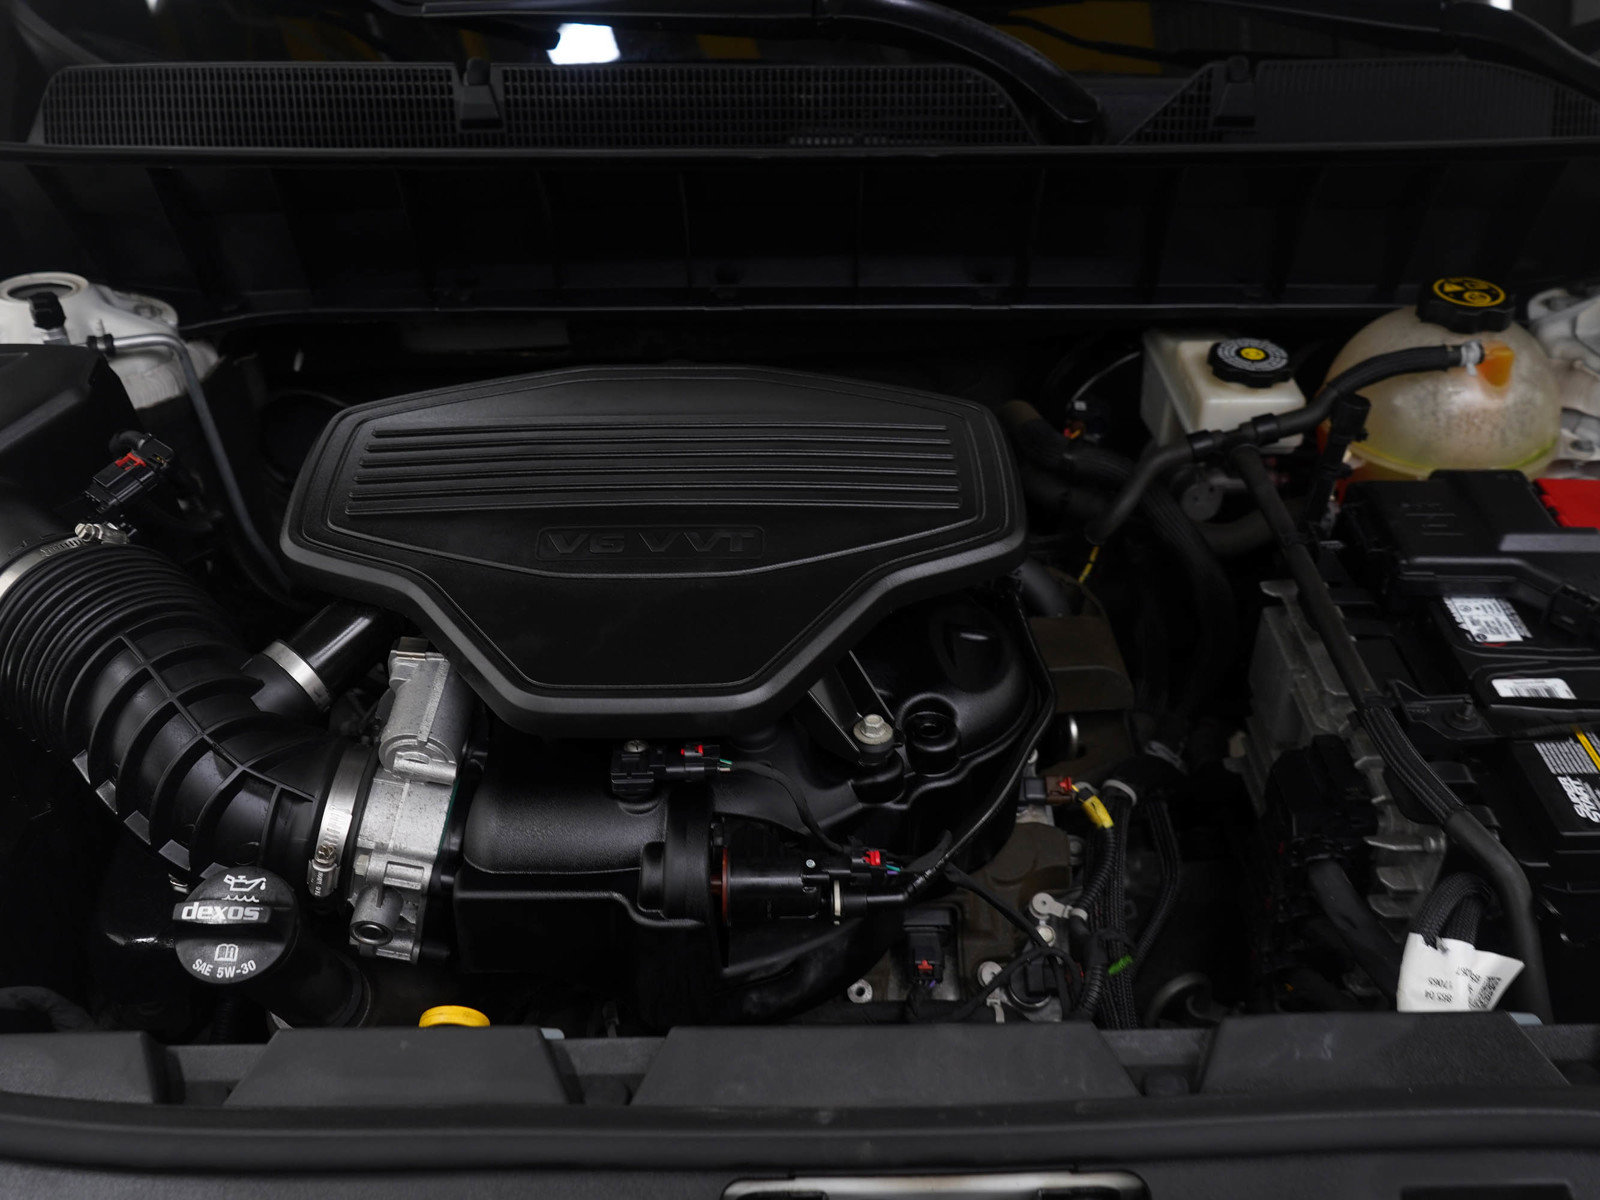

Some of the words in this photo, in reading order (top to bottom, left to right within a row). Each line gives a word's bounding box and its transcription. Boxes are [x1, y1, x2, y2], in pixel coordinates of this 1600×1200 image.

[548, 532, 625, 553] V6
[638, 531, 755, 552] VVT
[1557, 776, 1587, 818] SUPER
[1566, 775, 1600, 823] START
[181, 902, 261, 920] dexos
[192, 958, 213, 976] SAE
[216, 960, 257, 978] 5W-30
